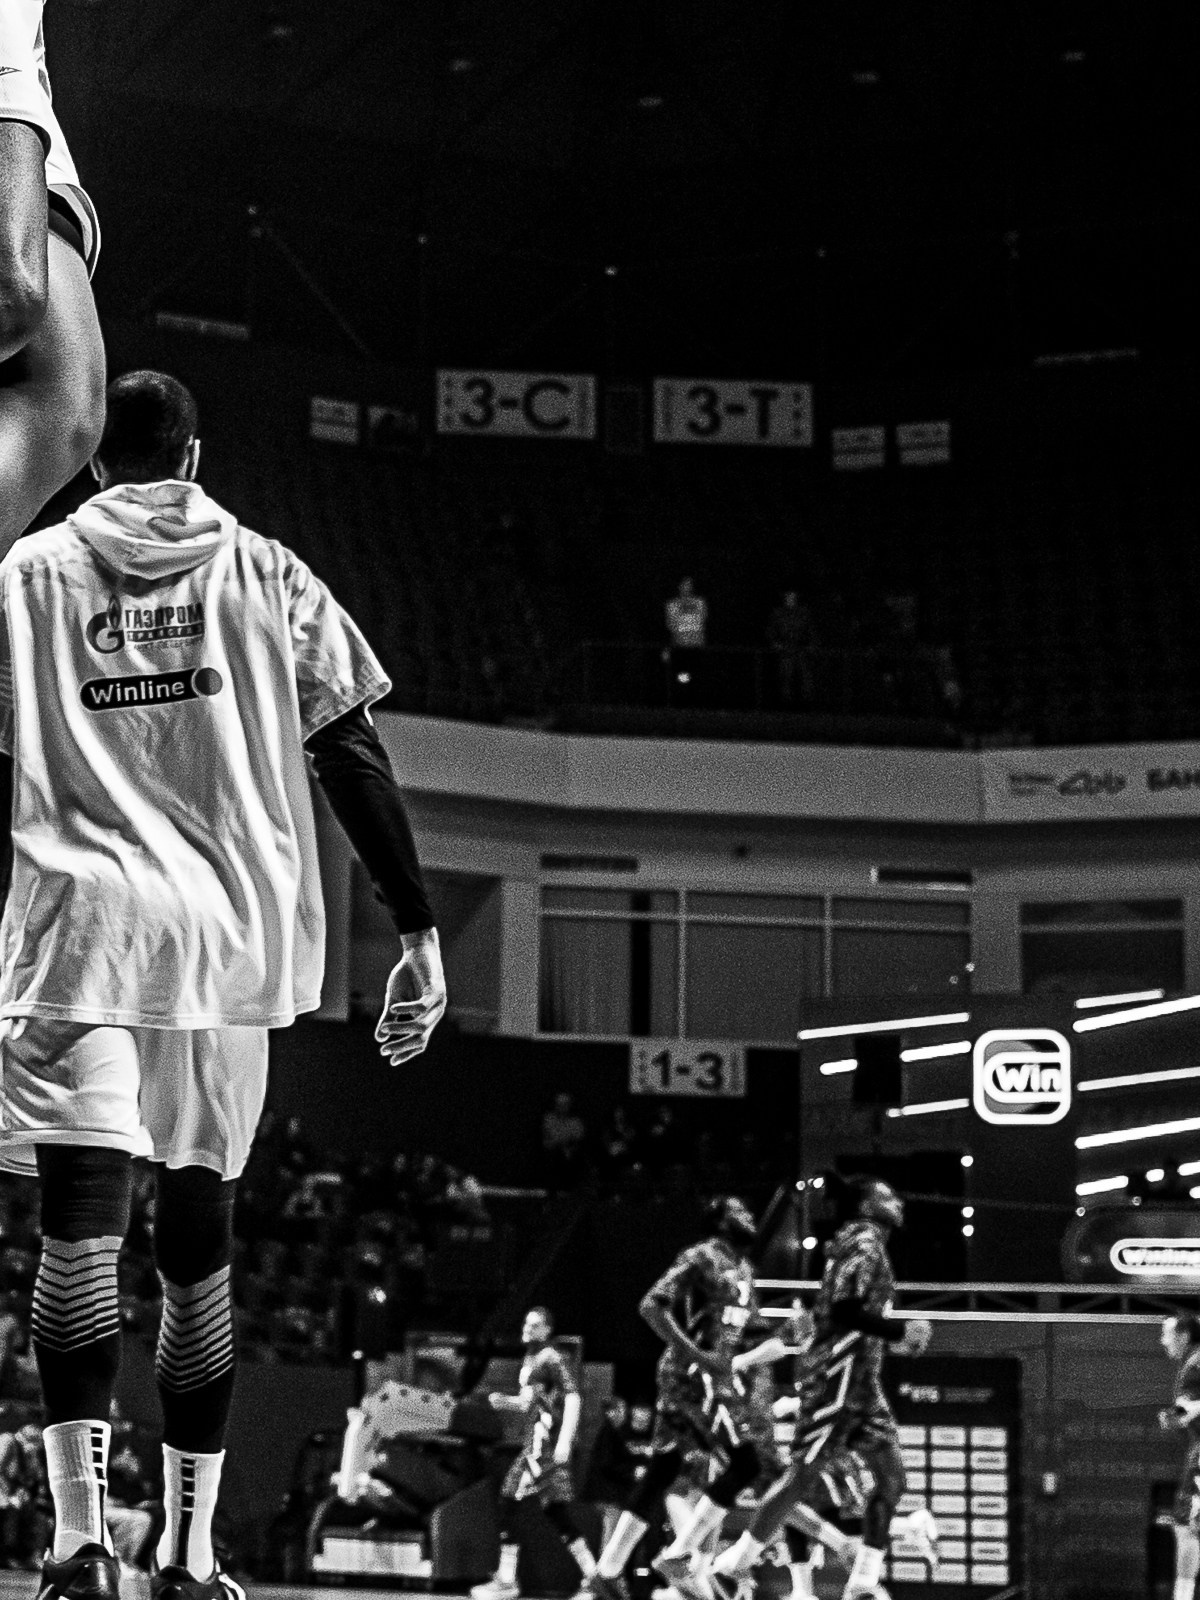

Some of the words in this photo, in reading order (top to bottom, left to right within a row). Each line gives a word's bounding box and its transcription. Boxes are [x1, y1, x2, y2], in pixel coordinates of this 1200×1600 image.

[125, 602, 204, 629] ГАЗПРОМ
[89, 680, 185, 705] Winline
[994, 1062, 1062, 1092] Win
